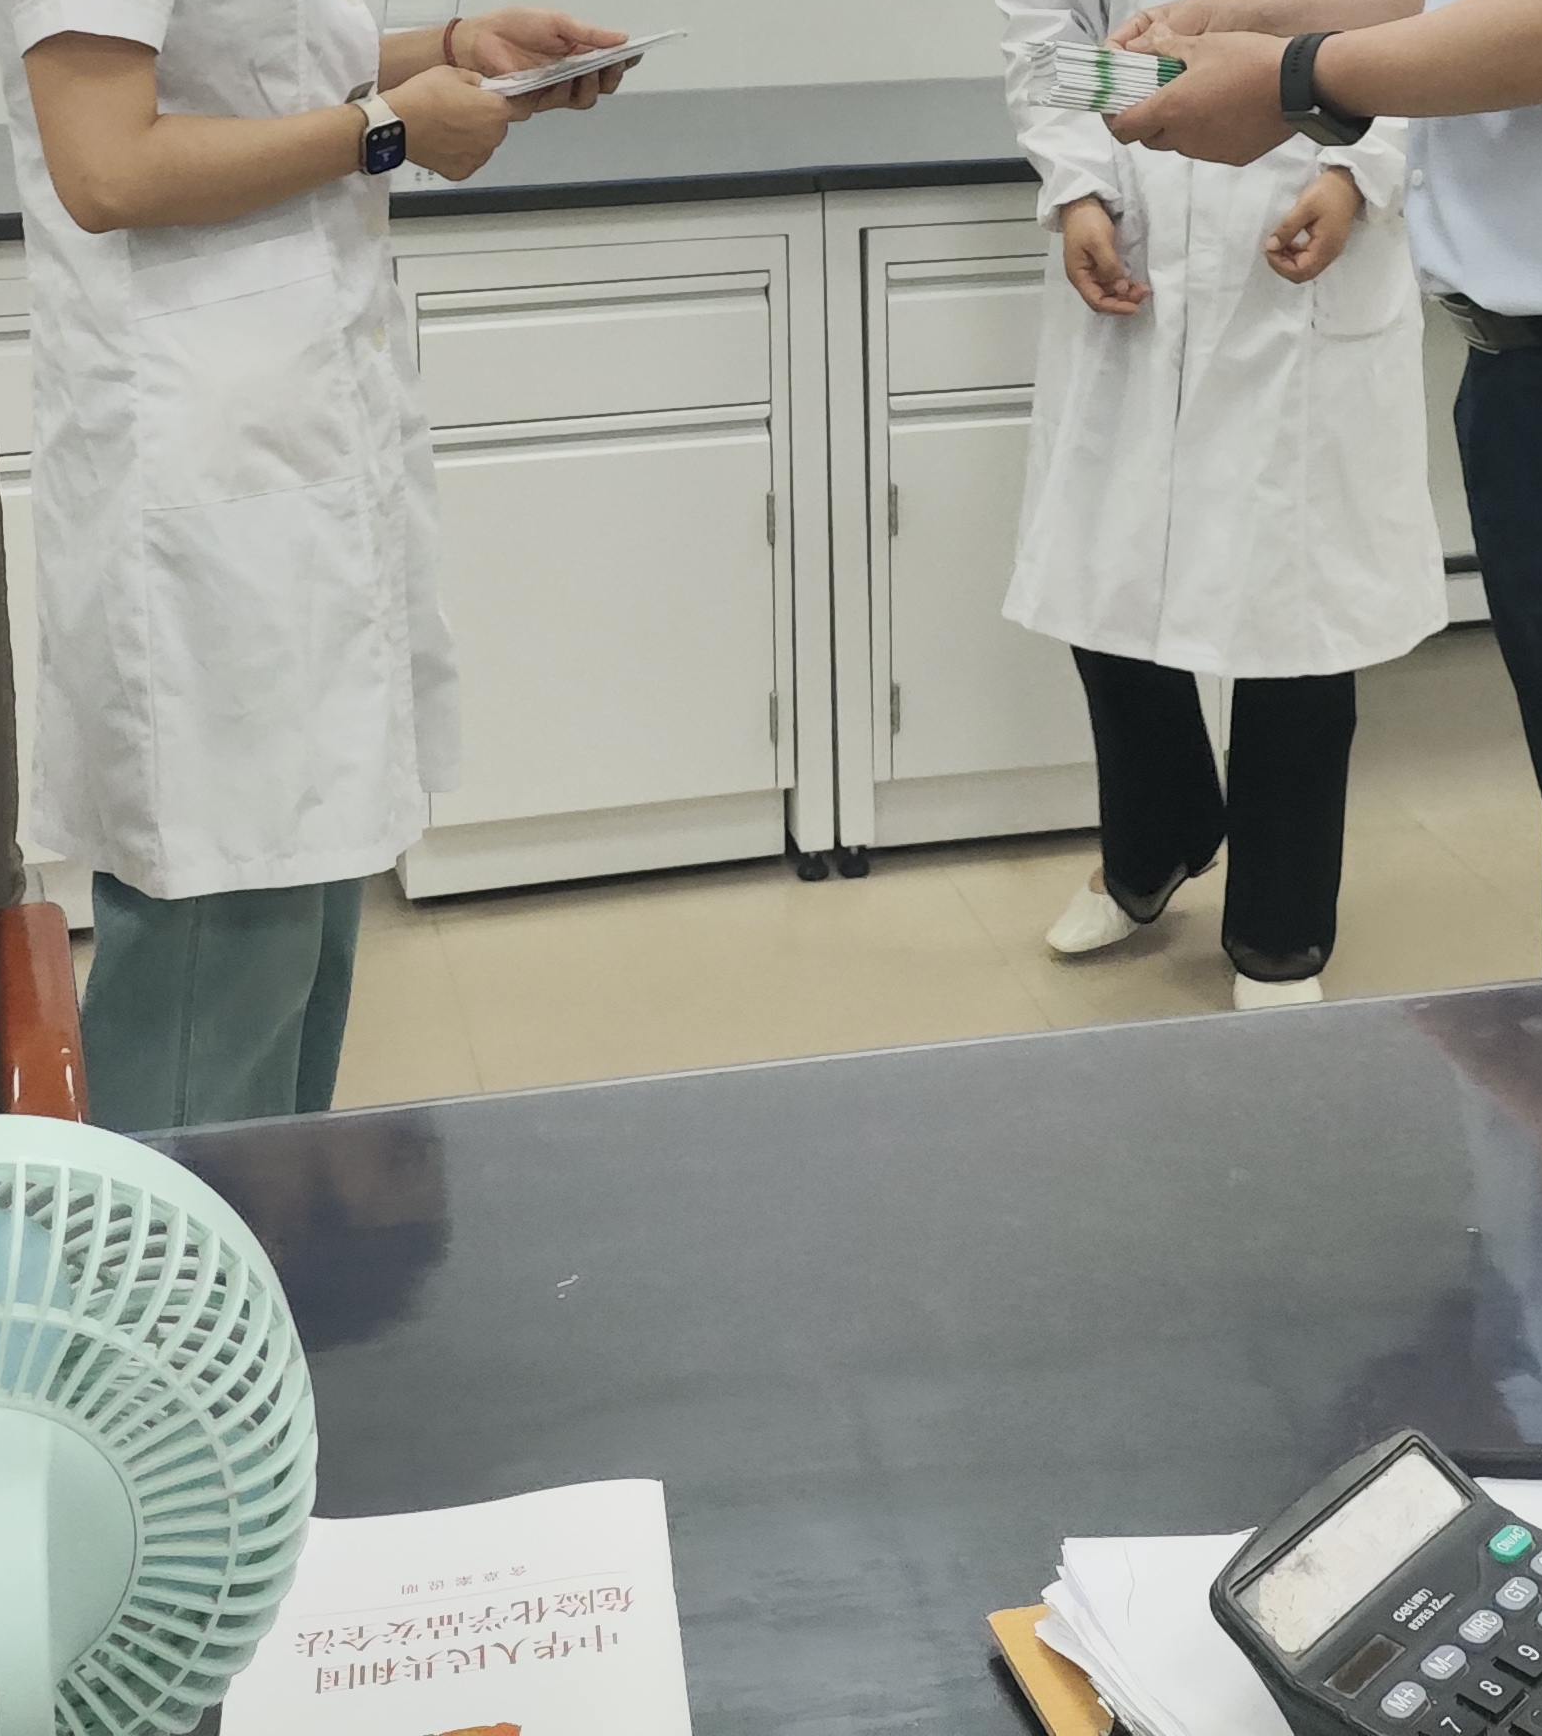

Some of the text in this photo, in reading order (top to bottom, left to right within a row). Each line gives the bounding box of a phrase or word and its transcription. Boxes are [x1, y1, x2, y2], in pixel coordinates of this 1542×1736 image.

[1503, 1580, 1531, 1602] GT
[295, 1585, 635, 1657] 危险化学品安全法
[1463, 1611, 1498, 1639] MRC
[314, 1624, 619, 1694] 中华人民共和国
[1517, 1644, 1540, 1661] 9
[1479, 1679, 1503, 1696] 8
[1387, 1687, 1417, 1712] M+
[1440, 1716, 1462, 1733] 7
